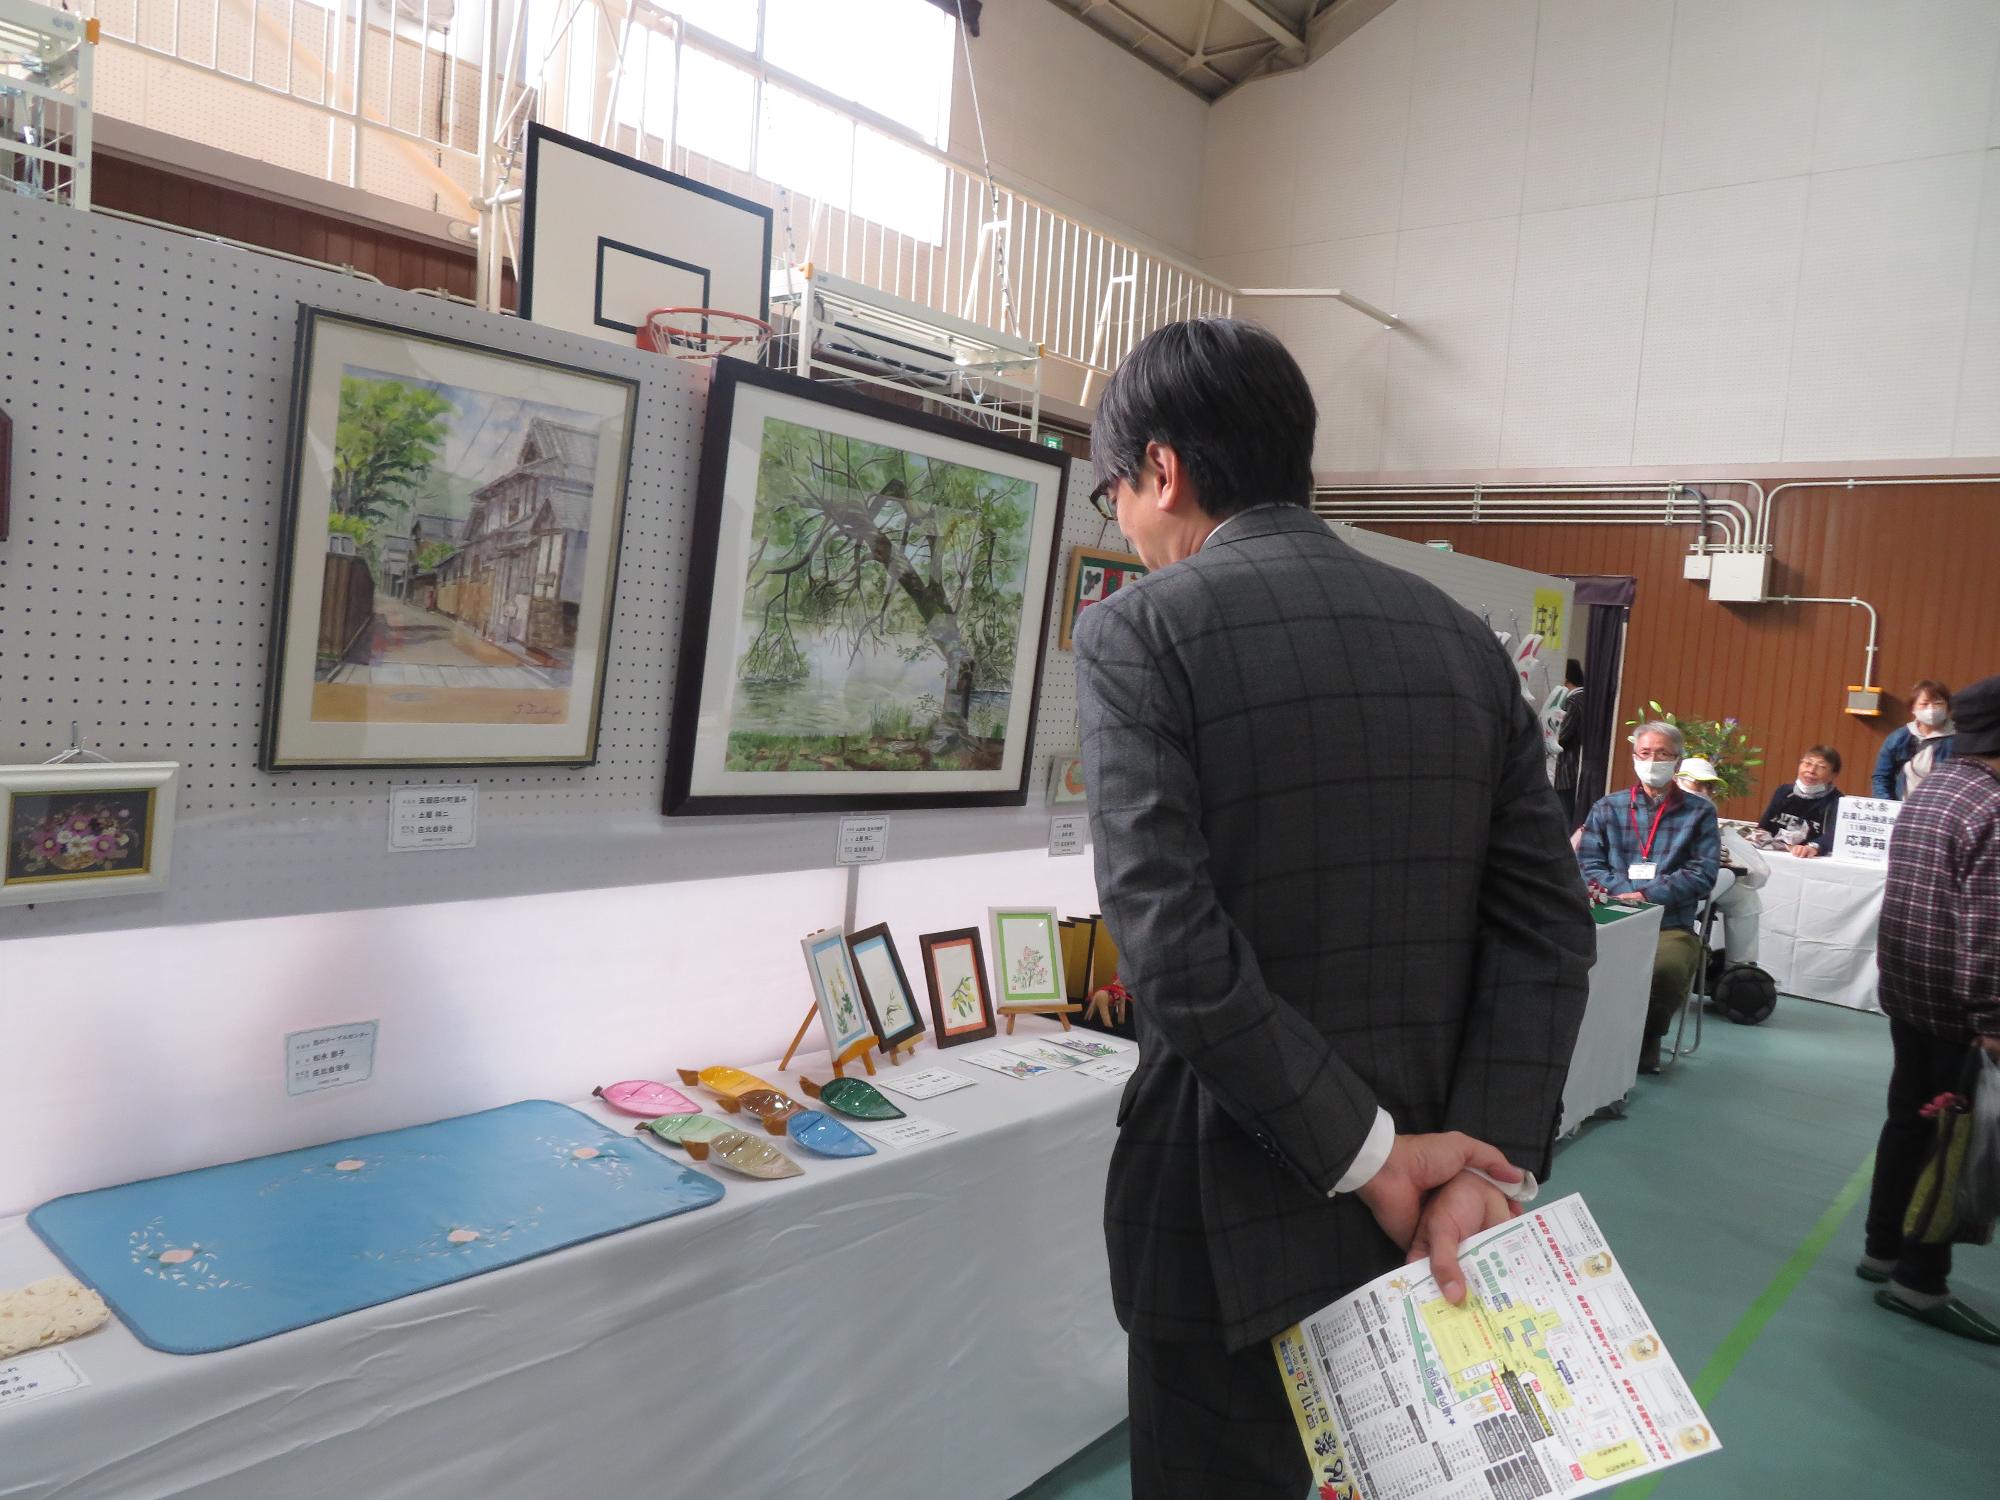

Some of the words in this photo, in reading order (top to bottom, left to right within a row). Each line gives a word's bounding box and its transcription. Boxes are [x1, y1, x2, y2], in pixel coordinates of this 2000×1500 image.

[1845, 834, 1887, 850] 応募箱
[1533, 1212, 1550, 1236] 応募券
[1546, 1234, 1576, 1288] お楽しみ抽選会
[1576, 1292, 1593, 1317] 応募券
[1588, 1316, 1622, 1371] お楽しみ抽選会
[1620, 1376, 1640, 1403] 応募券
[1635, 1402, 1672, 1461] お楽しみ抽選会
